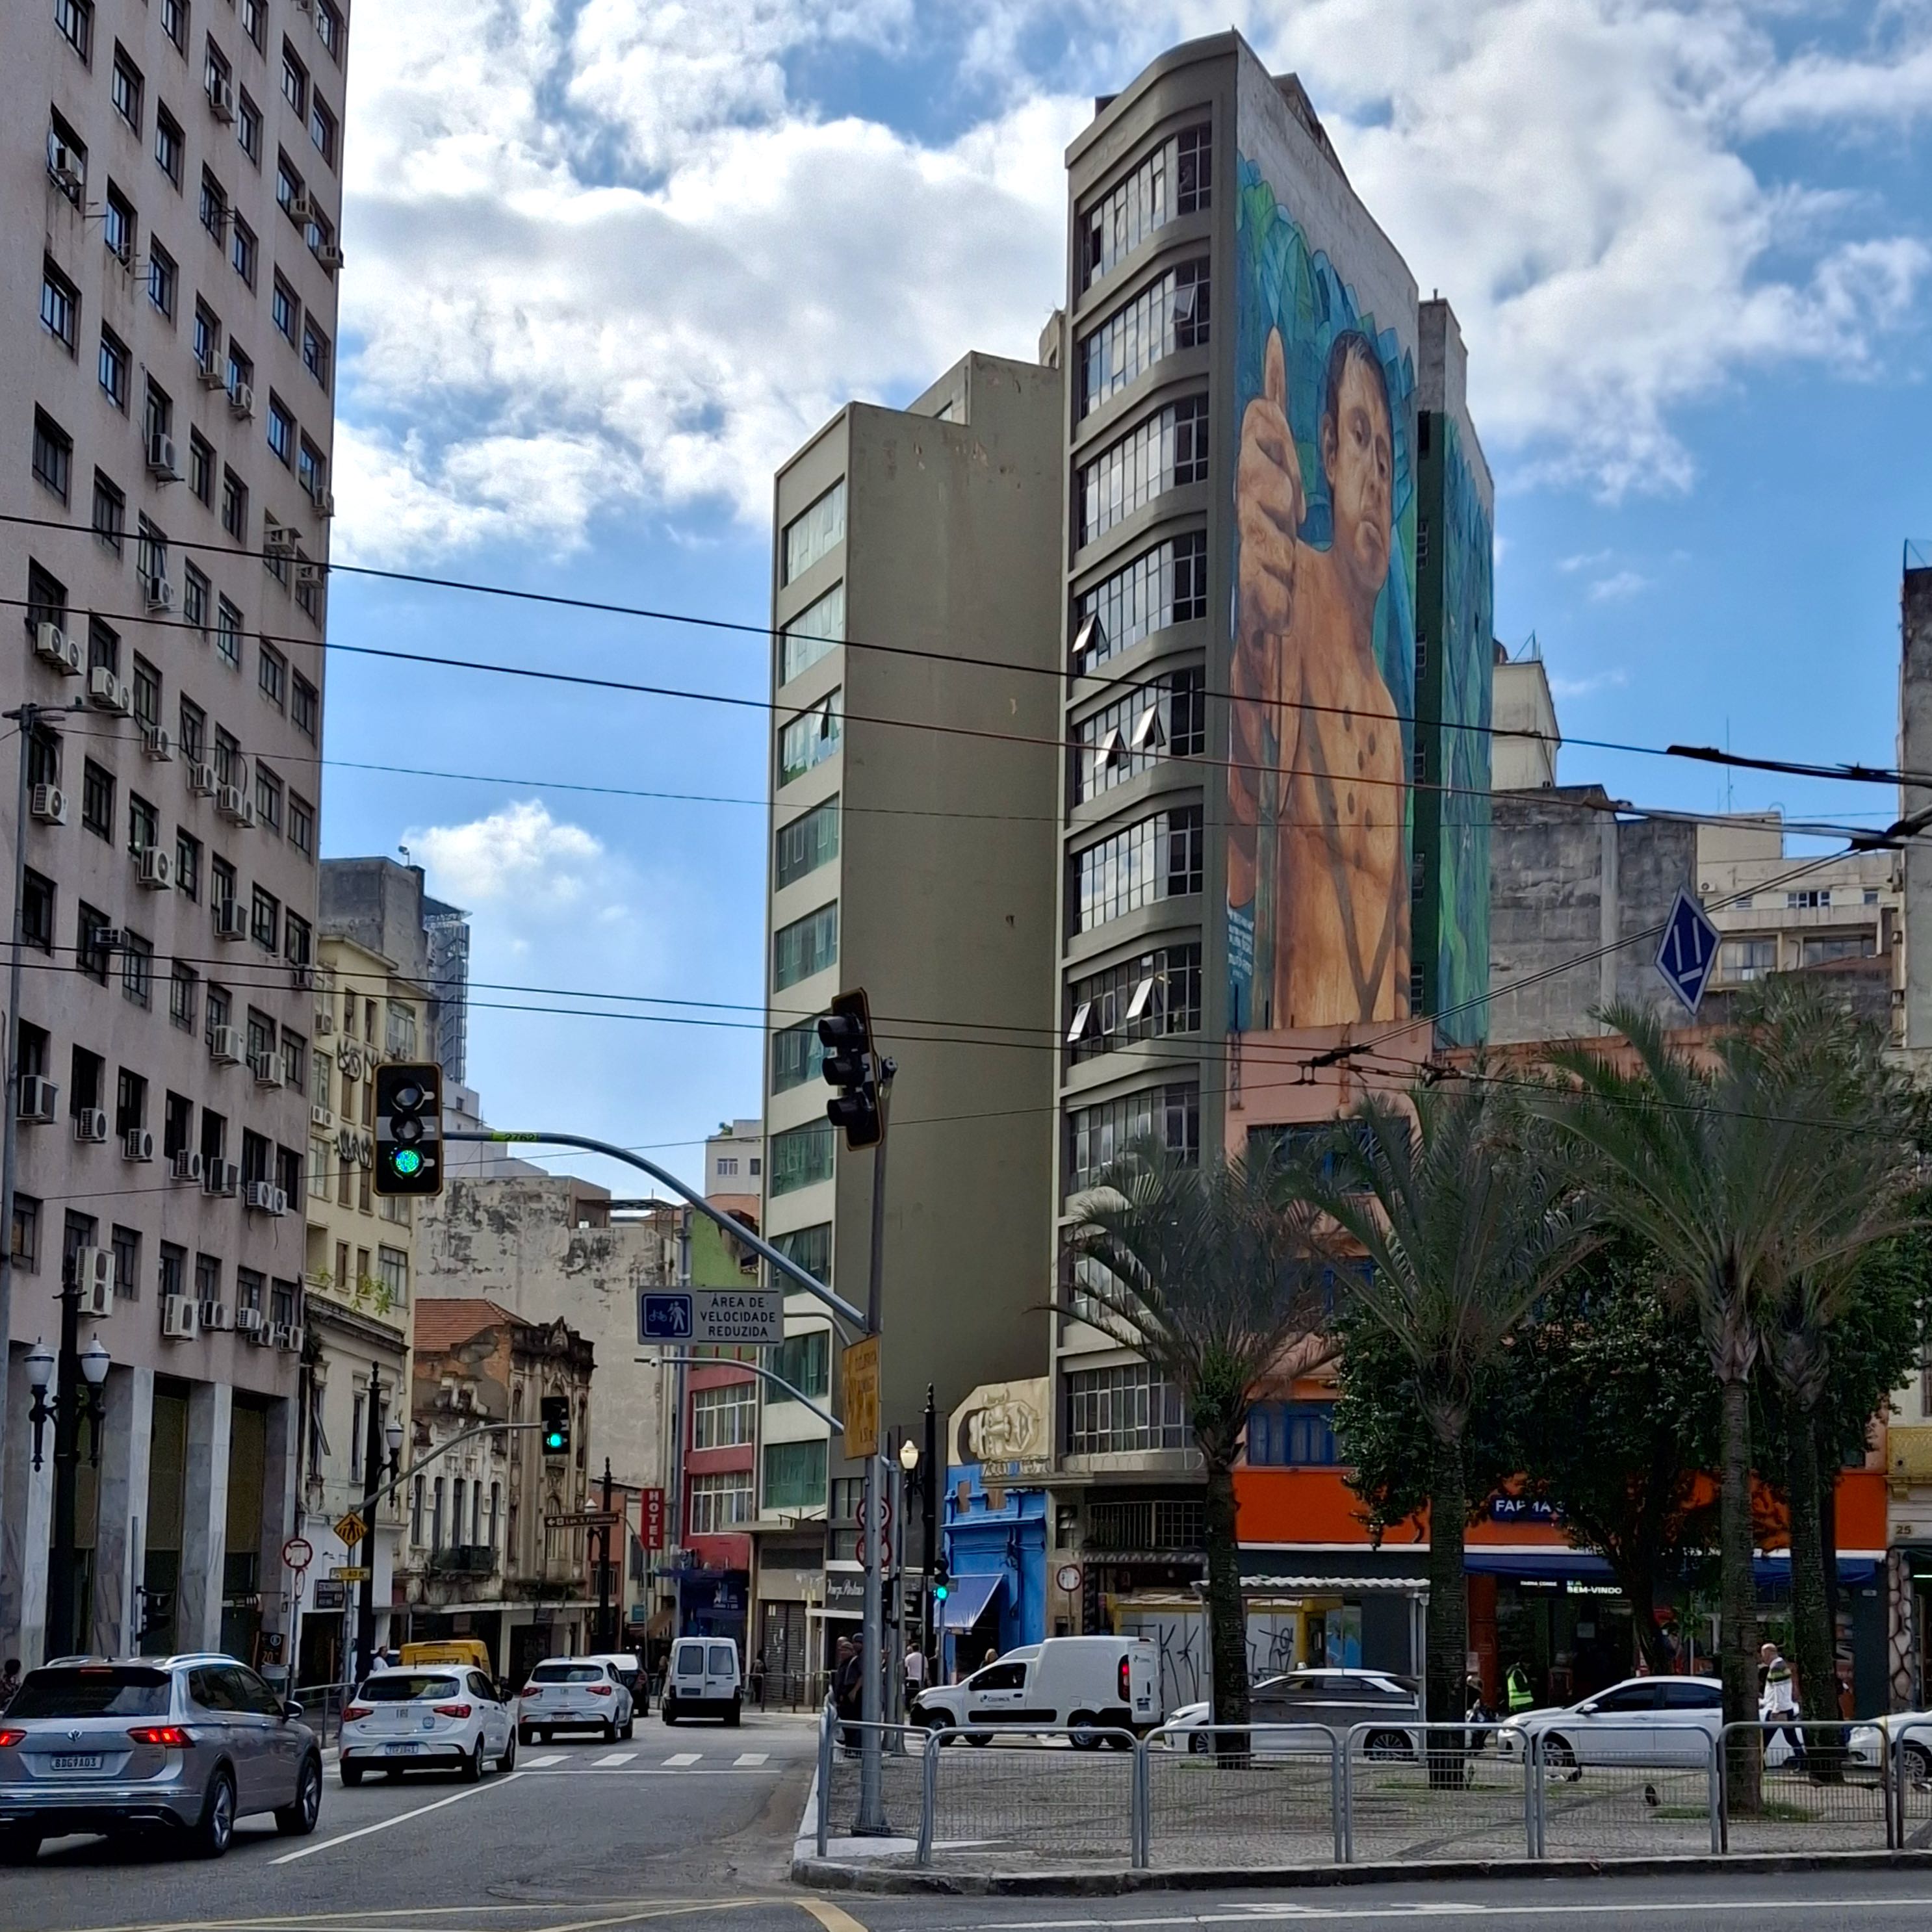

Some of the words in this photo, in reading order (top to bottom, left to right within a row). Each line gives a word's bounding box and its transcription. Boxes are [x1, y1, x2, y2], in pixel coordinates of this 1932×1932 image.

[712, 1293, 745, 1307] ÁREA
[749, 1297, 764, 1307] DE
[700, 1311, 775, 1322] VELOCIDADE
[708, 1326, 768, 1337] REDUZIDA
[649, 1491, 659, 1547] HOTEL
[1896, 1525, 1911, 1534] 25
[1566, 1586, 1623, 1595] BEM-VINDO
